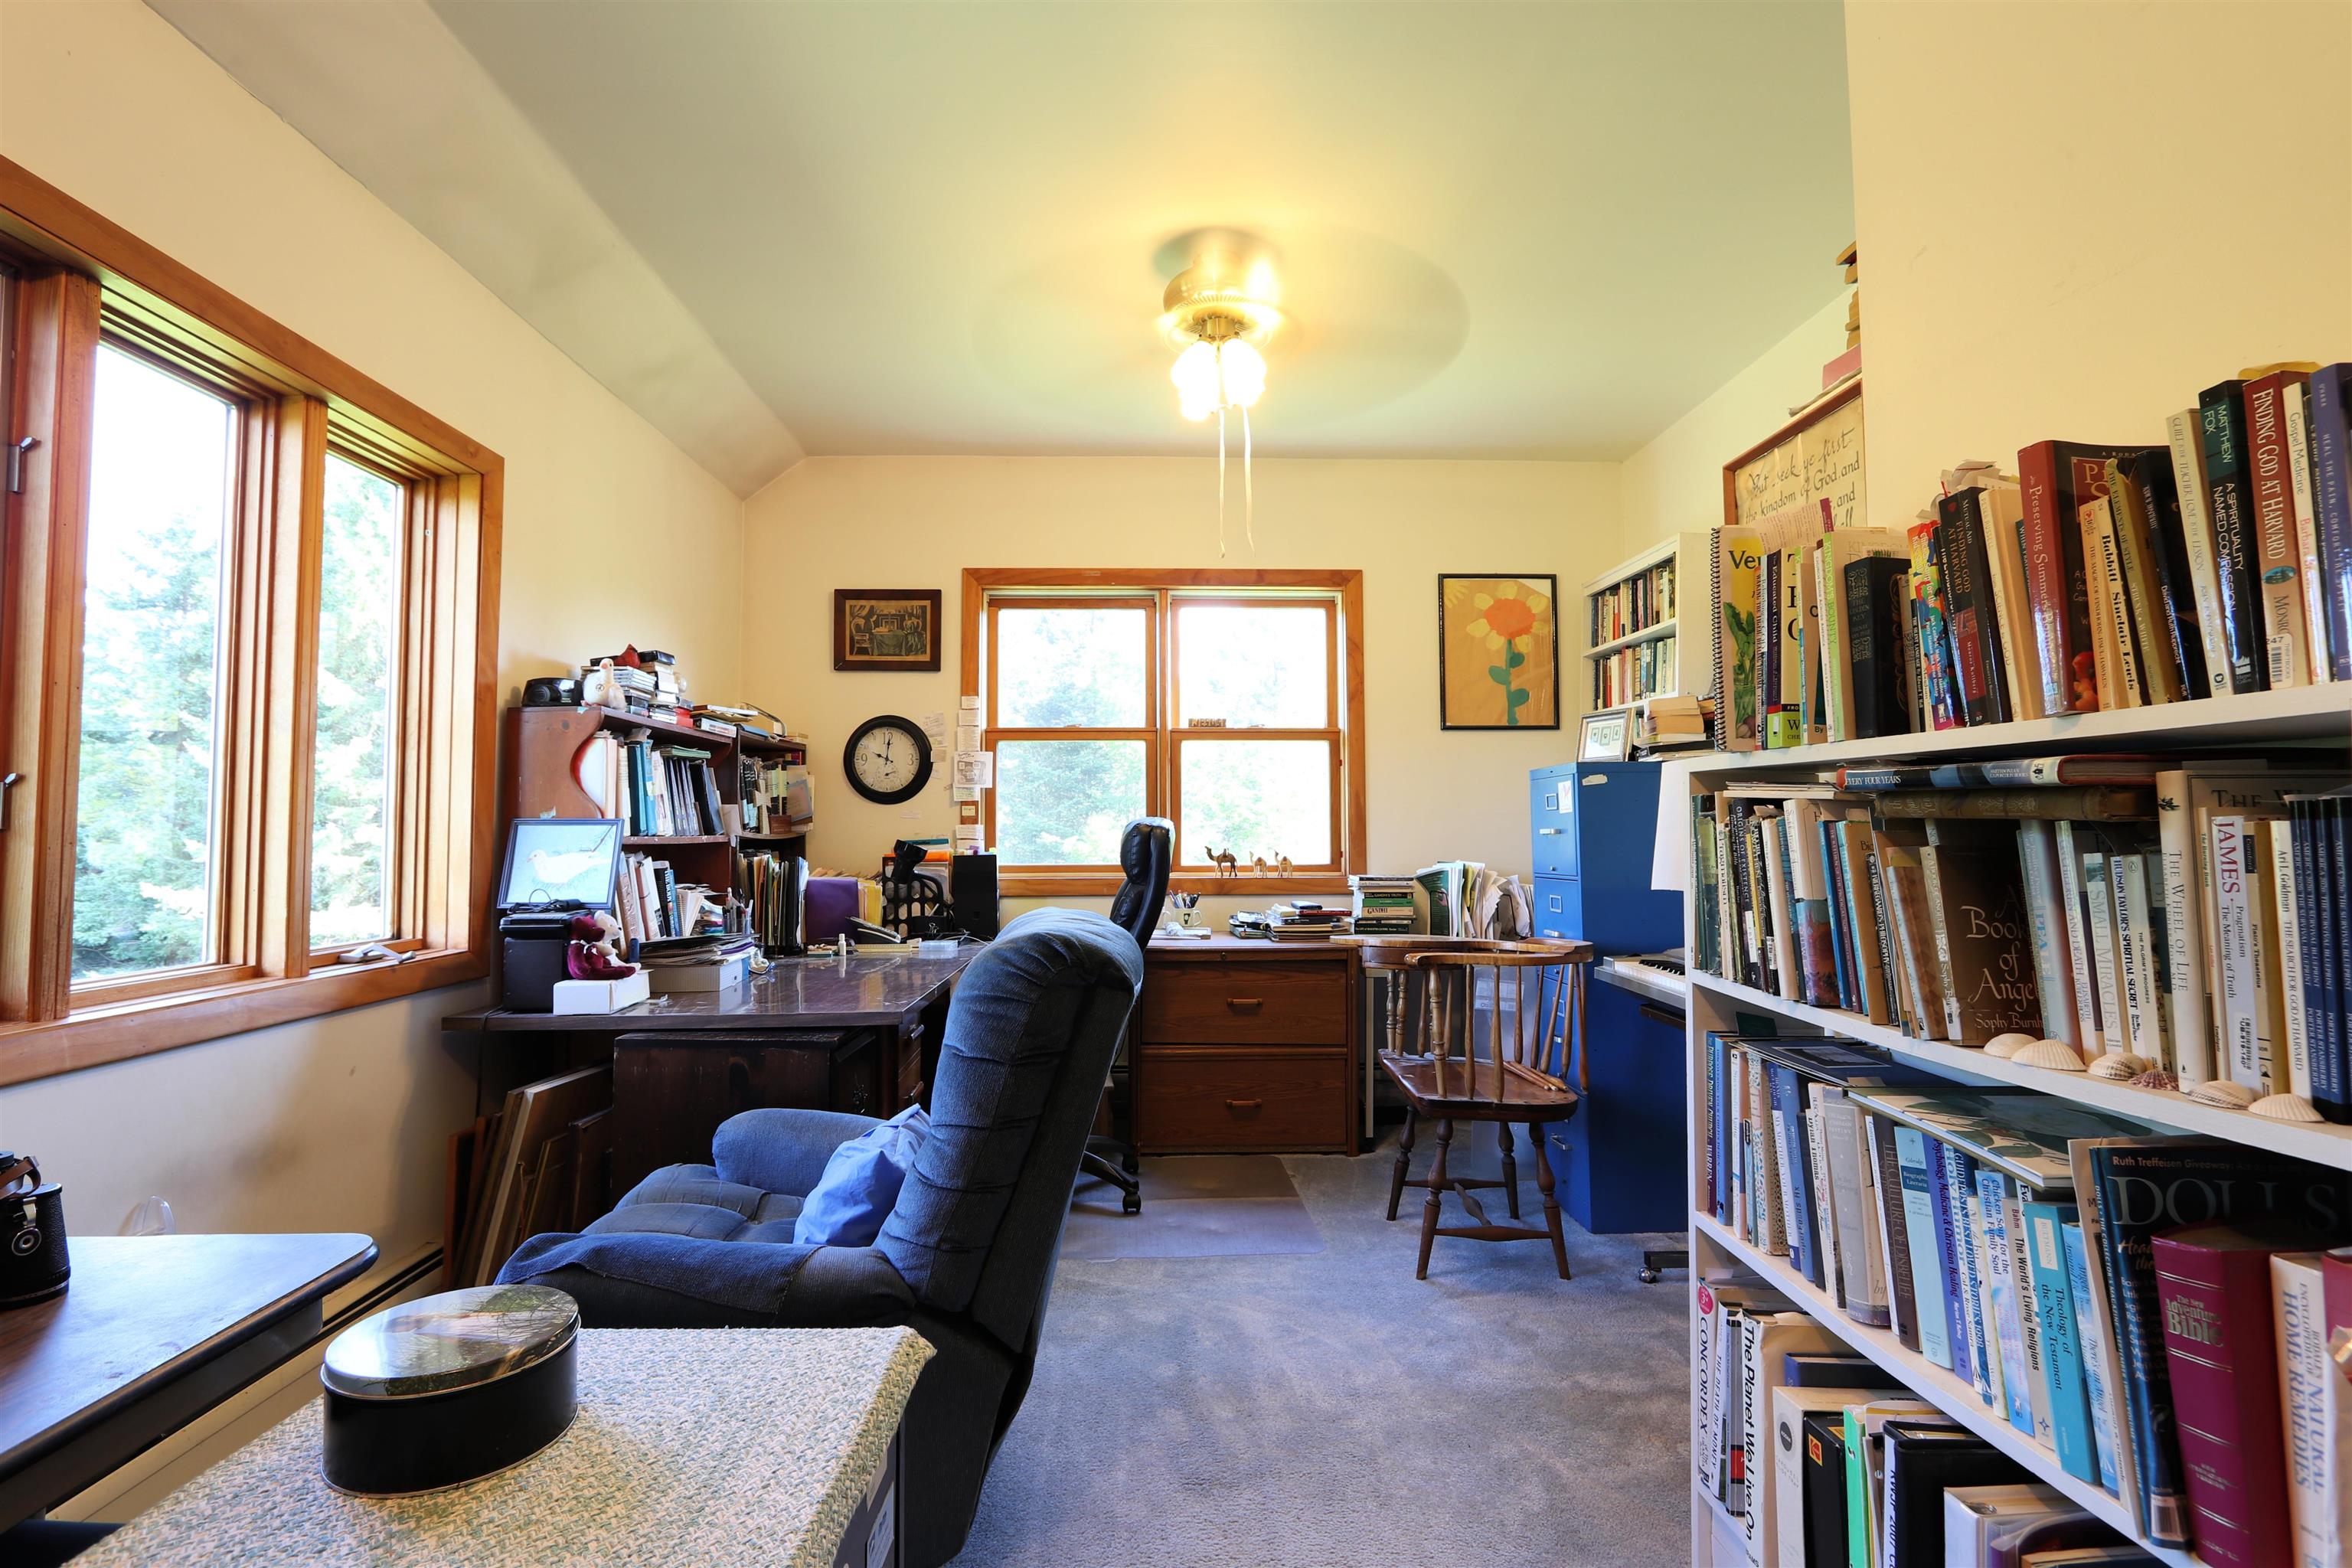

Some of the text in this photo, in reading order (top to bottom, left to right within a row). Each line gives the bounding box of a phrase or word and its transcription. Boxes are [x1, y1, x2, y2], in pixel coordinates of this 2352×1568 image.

[1818, 428, 1854, 473] first
[2204, 410, 2216, 435] FOX
[2217, 405, 2232, 463] MATTHEW
[2288, 412, 2306, 495] Gospel Medicine
[1761, 491, 1796, 518] kingdom
[1841, 451, 1860, 476] and
[1837, 482, 1856, 508] and
[2179, 462, 2197, 519] TEACHER LOVE
[2252, 388, 2285, 560] FINDING GOD AT HARVARD
[2323, 433, 2341, 554] HEAL THE COMFORT
[1962, 499, 1971, 529] MUTUAL
[2028, 485, 2045, 550] Preserving
[2108, 472, 2135, 572] THE ELEMENTS OF STYLE
[2226, 492, 2243, 570] SPIRITUALITY
[2299, 518, 2311, 557] Barbara
[1919, 533, 1929, 560] Chicken
[1922, 563, 1932, 580] Soup
[1948, 528, 1963, 593] AT HARVARD
[1955, 521, 1971, 592] FINDING GOD
[2213, 487, 2236, 611] NAMED COMPASSION
[1828, 603, 1837, 643] BOUNTY
[1994, 590, 2011, 666] SCIENCE GOD
[2102, 535, 2137, 690] Babbitt Sinclair Lewis
[2138, 623, 2150, 652] WHITE
[861, 753, 867, 766] 9
[882, 732, 893, 746] 12
[907, 753, 914, 766] 3
[1864, 775, 1902, 785] FOUR YEARS
[1736, 806, 1749, 903] ORIGINS OF EXISTENCE
[2213, 819, 2240, 893] JAMES
[2246, 838, 2254, 870] Cornford
[2277, 851, 2292, 912] Ari Goldman
[1960, 903, 2026, 940] Book
[2035, 913, 2051, 975] PEALE
[2069, 914, 2085, 975] AND DEATH
[2089, 890, 2109, 944] SMALL
[2113, 860, 2138, 1010] HUDSON TAYLOR'S SPIRITUAL SECRET
[2168, 851, 2190, 991] THE WHEEL OF LIFE
[2234, 906, 2247, 957] Pragmatism
[1941, 963, 1951, 987] Sophy
[1999, 942, 2029, 982] of
[2221, 905, 2236, 998] The Meaning of Truth
[2301, 946, 2311, 985] BLUEPRINT
[2310, 946, 2320, 987] BLUEPRINT
[2321, 910, 2332, 990] SURVIVAL BLUEPRINT
[2340, 912, 2351, 991] SURVIVAL BLUEPRINT
[2096, 948, 2118, 1029] MIRACLES
[2283, 920, 2303, 1070] THE SEARCH FOR GOD AT HARVARD
[1975, 1013, 2007, 1030] Sophy
[2307, 1008, 2319, 1087] PORTER STANSBERRY
[2315, 1009, 2328, 1089] PORTER STANSBERRY
[2327, 1012, 2338, 1094] PORTER STANSBERRY
[1932, 1139, 1949, 1181] Psychology,
[2113, 1156, 2182, 1168] Ruth Treffeisen
[1939, 1182, 1951, 1217] Medicine
[1981, 1178, 2001, 1275] Christian Family Soul
[1991, 1180, 2010, 1274] Chicken Soup for the
[2011, 1208, 2021, 1229] Bahm
[1890, 1172, 1912, 1299] CULTURE OF DISBELIEF
[1944, 1227, 1956, 1265] Christian
[1952, 1196, 1966, 1266] Humor
[1954, 1153, 1981, 1322] GUIDEPOSTS STORIES
[1947, 1267, 1960, 1298] Healing
[2014, 1237, 2041, 1370] The World's Living Religions
[2101, 1233, 2112, 1283] COLLECTOR'S
[2109, 1286, 2119, 1326] MAGAZINE
[2115, 1335, 2126, 1378] SEPTEMBER
[1744, 1326, 1755, 1355] The
[2041, 1284, 2063, 1390] the New Testament
[2054, 1288, 2072, 1356] Theology of
[2168, 1312, 2224, 1348] Bible
[1700, 1317, 1709, 1433] CONCORDEX
[1744, 1357, 1755, 1425] Planet
[2282, 1290, 2311, 1489] HOME REMEDIES
[1744, 1431, 1755, 1462] We
[2307, 1381, 2326, 1494] NATURAL
[1744, 1465, 1755, 1506] Live
[1745, 1510, 1755, 1541] On
